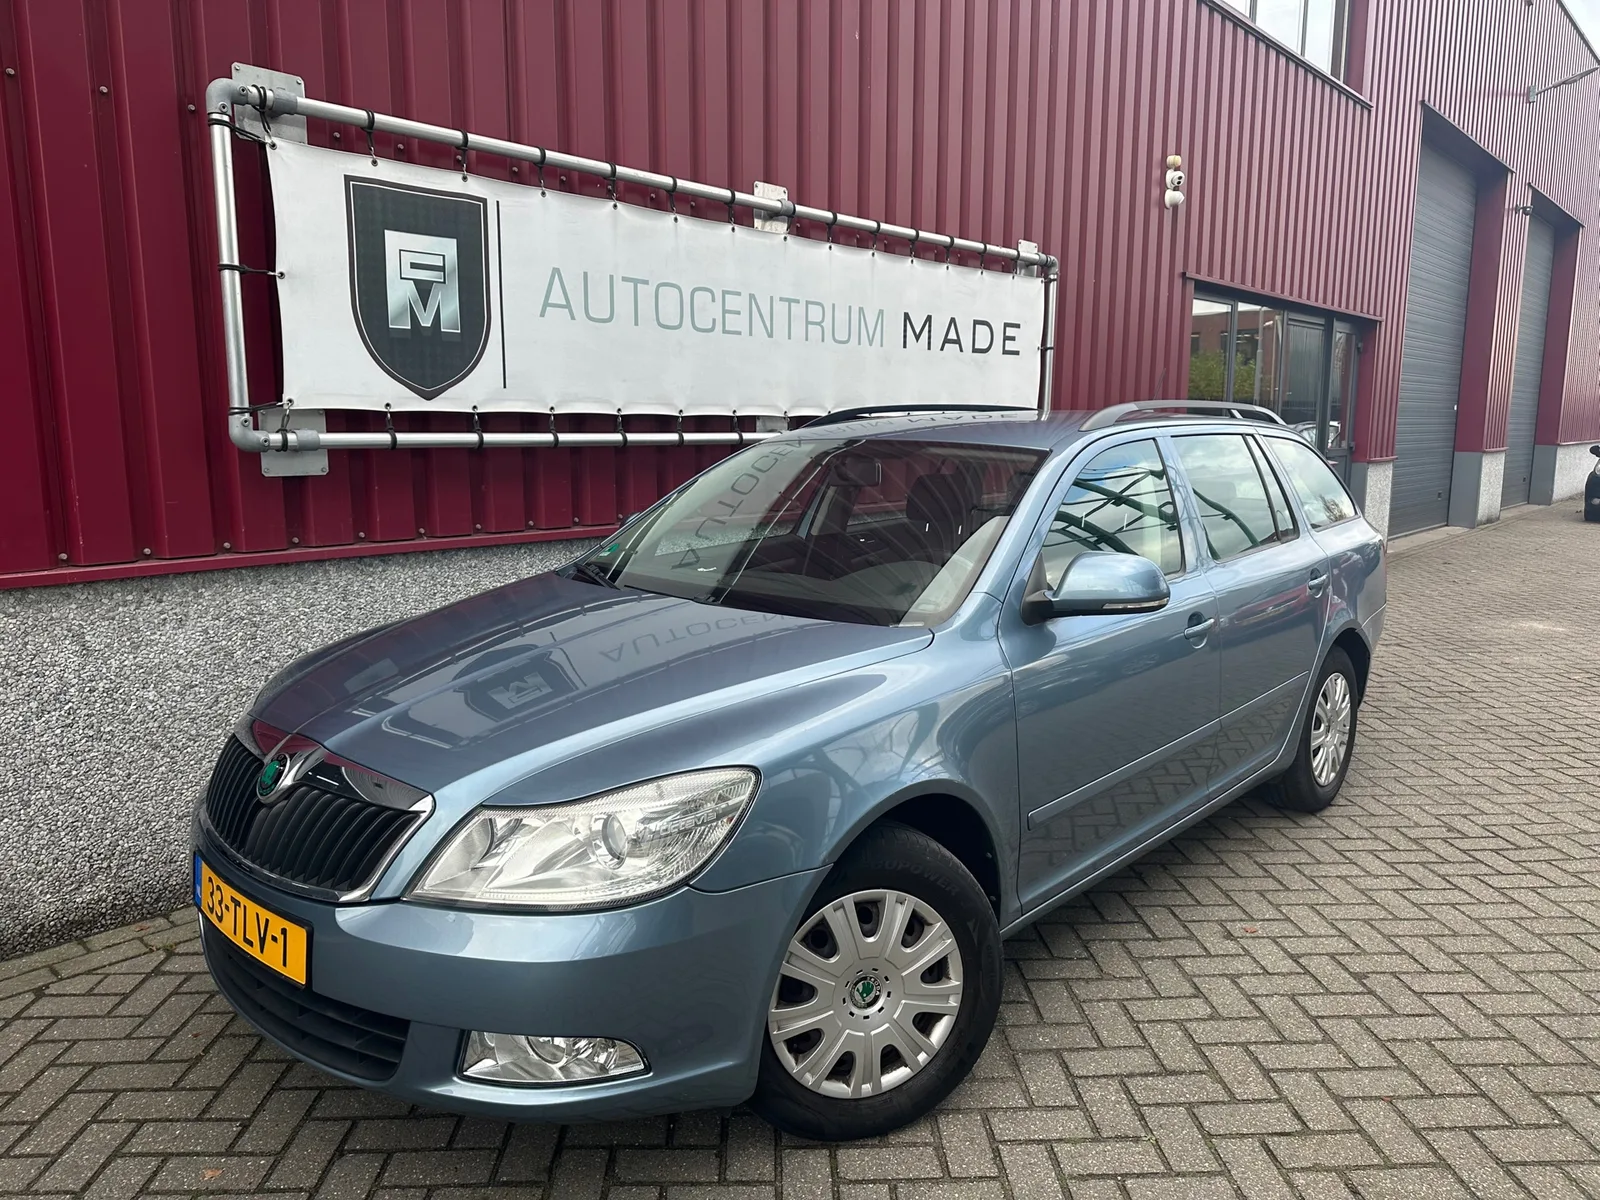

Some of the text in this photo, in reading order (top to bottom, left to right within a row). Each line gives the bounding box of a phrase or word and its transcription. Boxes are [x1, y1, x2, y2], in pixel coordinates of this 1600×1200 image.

[539, 266, 1022, 356] AUTOCENTRUM MADE
[206, 875, 288, 969] 33-TLV-1
